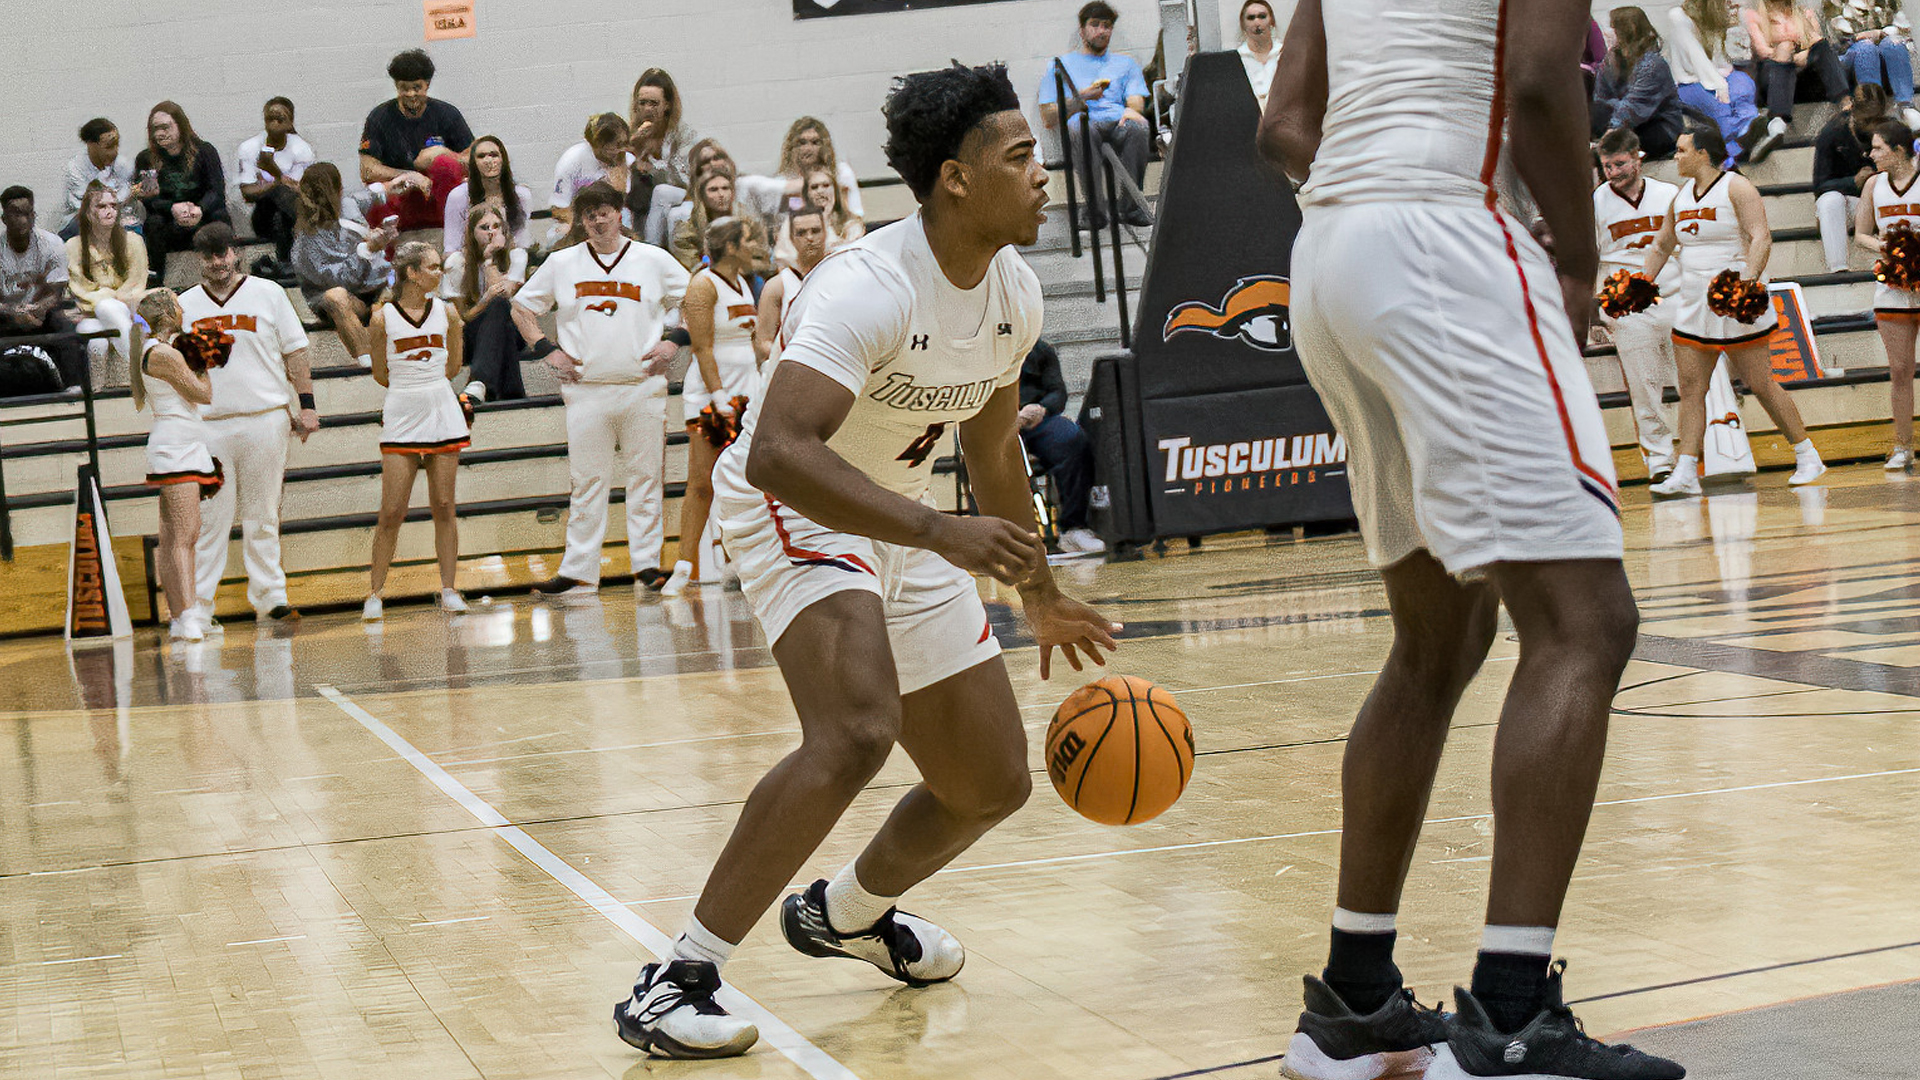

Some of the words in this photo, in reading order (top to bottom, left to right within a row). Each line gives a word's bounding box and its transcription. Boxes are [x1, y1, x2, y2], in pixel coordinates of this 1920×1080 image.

[869, 372, 998, 411] TUSCULU
[894, 421, 945, 468] 4
[1158, 433, 1347, 482] TUSCULUM
